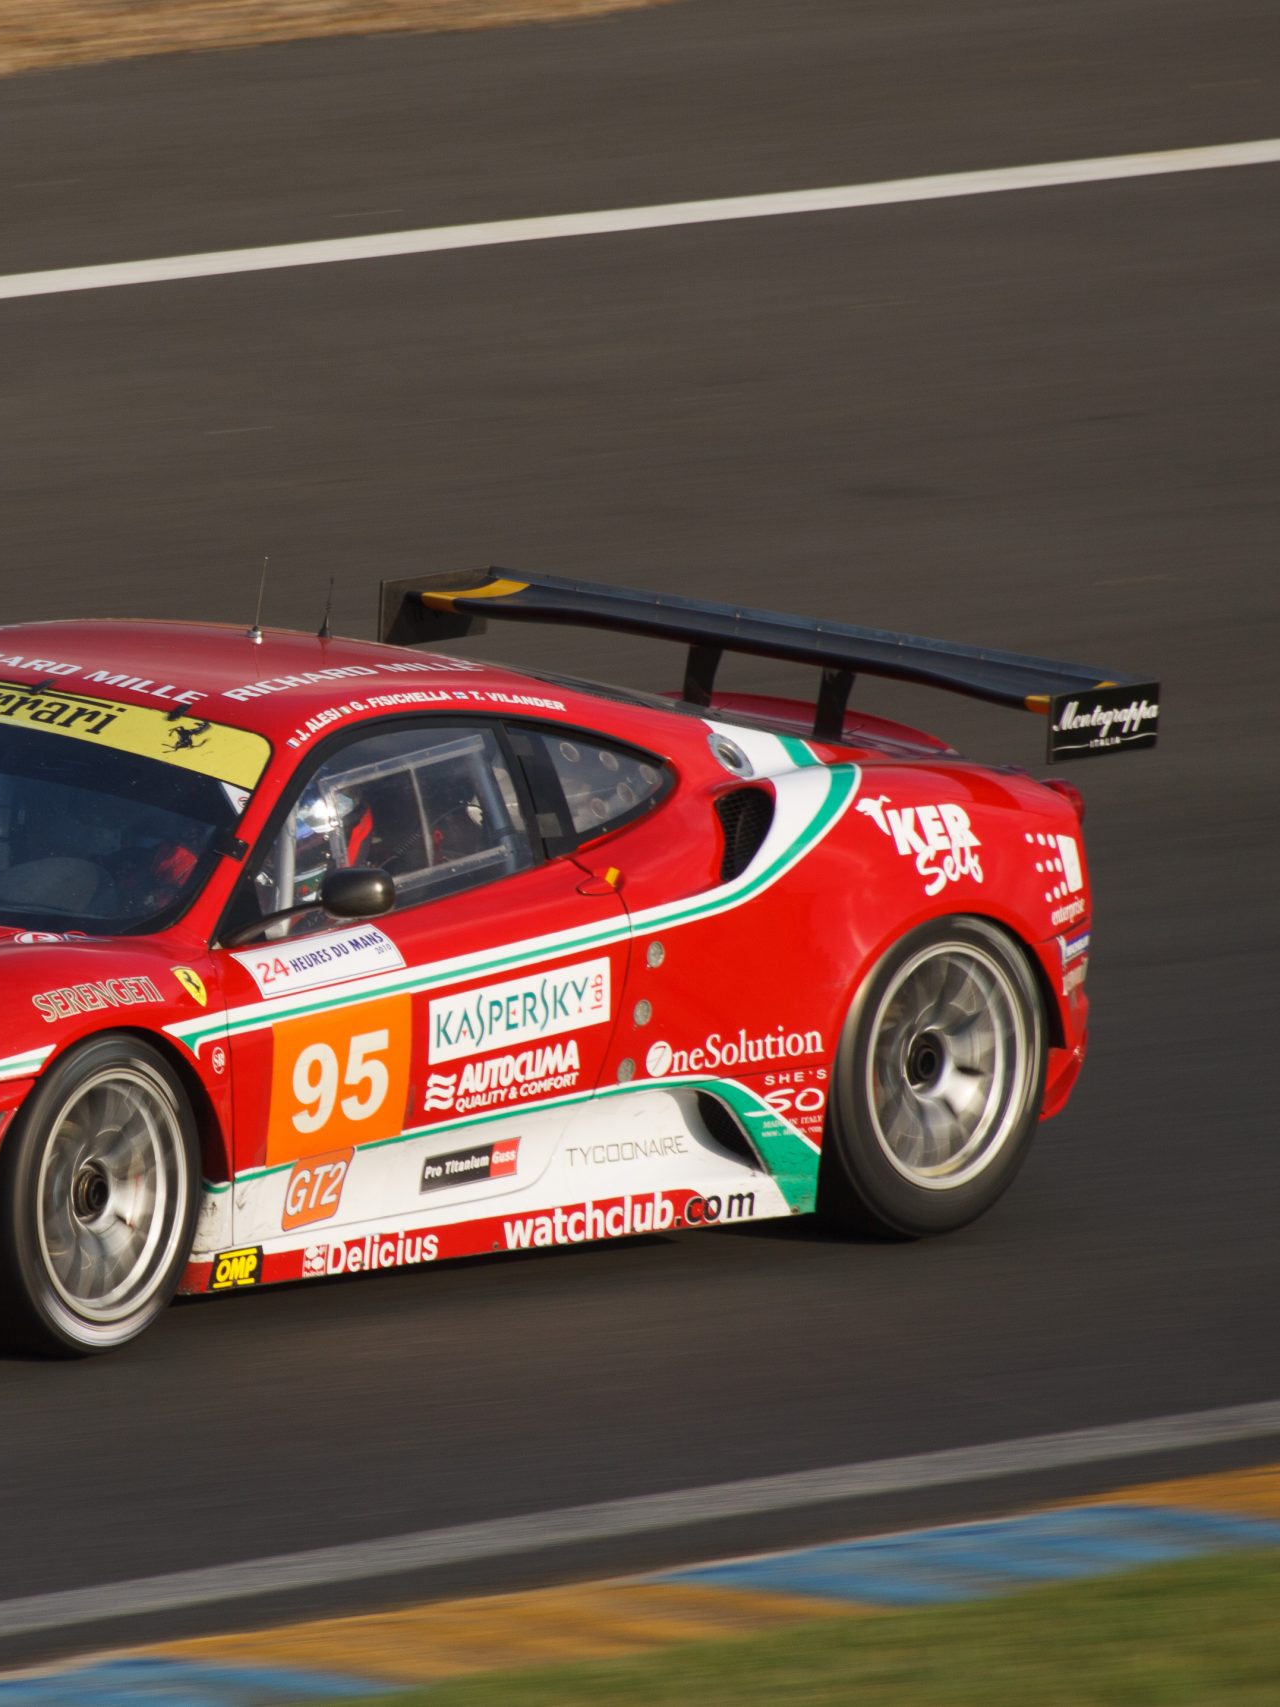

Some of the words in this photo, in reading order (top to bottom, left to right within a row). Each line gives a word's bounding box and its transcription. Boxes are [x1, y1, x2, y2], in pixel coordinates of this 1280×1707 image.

[83, 669, 209, 705] MILLE
[221, 665, 379, 702] RICHARD
[295, 729, 311, 742] J.
[304, 708, 343, 733] ALESI
[349, 701, 370, 712] G.
[366, 690, 453, 708] FISICHELLA
[468, 690, 486, 701] T.
[485, 691, 568, 712] VILANDER
[1052, 700, 1160, 738] Montegrappa
[886, 803, 982, 856] KER
[256, 958, 290, 984] 24
[289, 949, 333, 973] HEURES
[330, 943, 350, 958] DU
[348, 932, 384, 952] MANS
[32, 976, 164, 1024] SERENGETI
[435, 976, 589, 1048] KASPERSKY
[590, 973, 604, 1010] lab
[291, 1028, 390, 1133] 95
[457, 1040, 580, 1096] AUTOCLIMA
[455, 1088, 509, 1112] QUALITY
[508, 1086, 518, 1100] &
[520, 1072, 580, 1097] COMFORT
[743, 1087, 825, 1117] SO
[424, 1165, 443, 1180] Pro
[444, 1155, 490, 1175] Titanium
[565, 1135, 689, 1167] TYCOONAIRE
[286, 1160, 347, 1217] GT2
[503, 1191, 755, 1249] watchclub.com
[216, 1255, 257, 1282] OMP
[326, 1232, 439, 1275] Delicius
